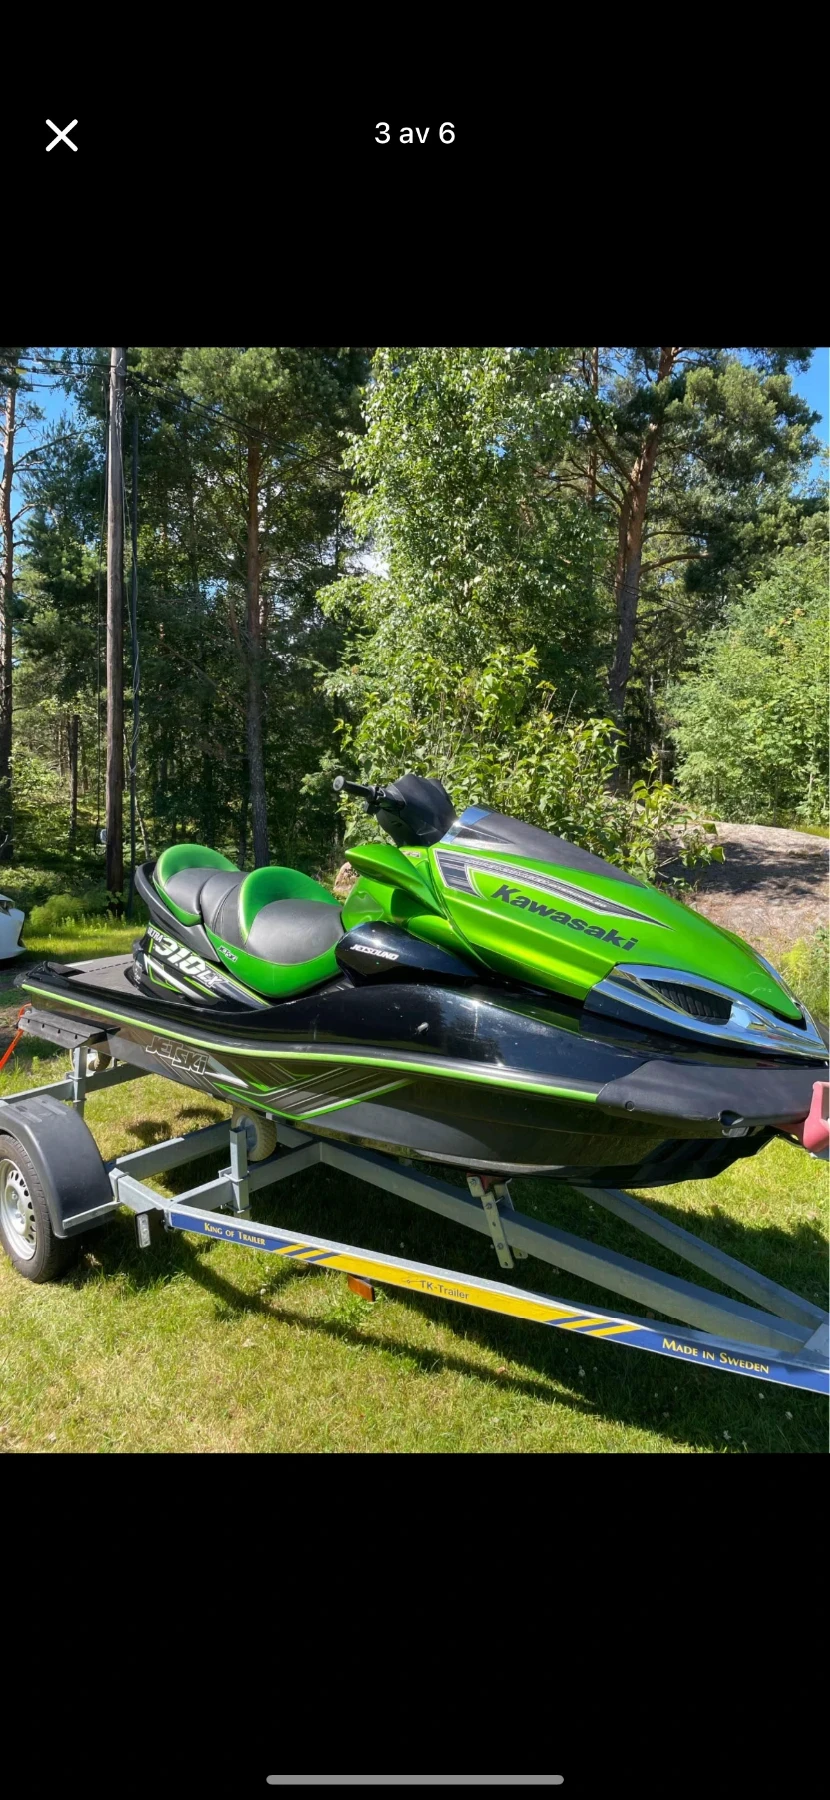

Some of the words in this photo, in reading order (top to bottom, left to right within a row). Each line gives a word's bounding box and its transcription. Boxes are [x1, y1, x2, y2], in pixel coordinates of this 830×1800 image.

[490, 884, 639, 951] Kawasaki
[349, 943, 400, 961] JETSOUND
[420, 1280, 470, 1300] TK-Trailer
